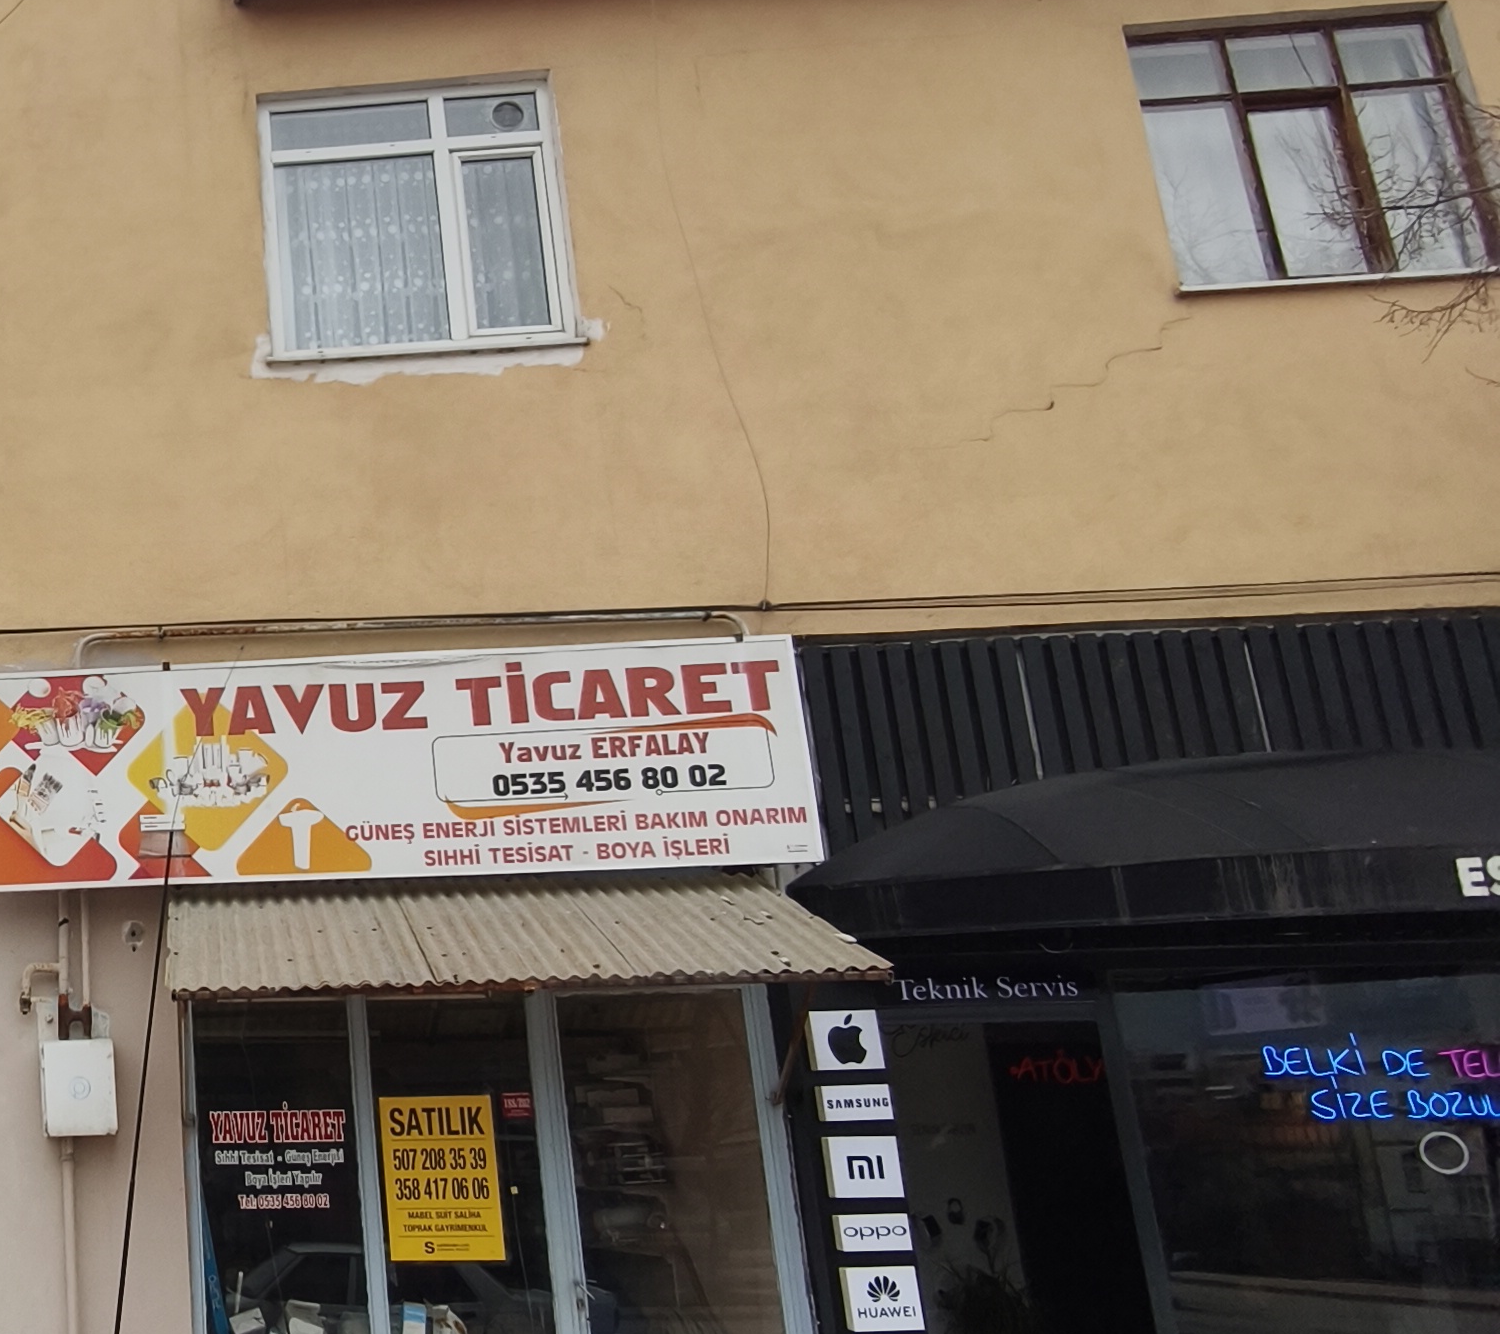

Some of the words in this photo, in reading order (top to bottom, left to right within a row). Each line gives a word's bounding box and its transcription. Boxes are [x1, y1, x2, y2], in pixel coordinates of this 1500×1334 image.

[179, 680, 428, 737] YAVUZ
[455, 660, 780, 727] TİCARET
[498, 742, 581, 763] Yavuz
[591, 732, 709, 759] ERFALAY
[492, 771, 566, 796] 0535
[576, 768, 632, 792] 456
[641, 766, 678, 789] 80
[689, 763, 727, 786] 02
[346, 821, 415, 844] GÜNEŞ
[503, 810, 627, 836] SİSTEMLERİ
[635, 810, 708, 830] BAKIM
[716, 806, 807, 827] ONARIM
[424, 844, 481, 866] SIHHİ
[488, 842, 573, 864] TESİSAT
[596, 842, 656, 860] BOYA
[662, 833, 730, 859] İŞLERİ
[895, 976, 989, 1001] Teknik
[996, 975, 1079, 998] Servis
[1262, 1032, 1366, 1076] BELKİ
[1382, 1049, 1431, 1077] DE
[1437, 1049, 1500, 1078] TEL
[827, 1097, 889, 1110] SAMSUNG
[1311, 1075, 1394, 1120] SİZE
[1407, 1089, 1500, 1118] BOZUL
[209, 1111, 268, 1143] YAVUZ
[270, 1101, 346, 1142] TİCARET
[389, 1106, 485, 1136] SATILIK
[393, 1149, 417, 1171] 507
[420, 1148, 446, 1170] 208
[449, 1148, 467, 1170] 35
[469, 1147, 487, 1169] 39
[245, 1171, 268, 1189] Boya
[395, 1178, 420, 1200] 358
[424, 1178, 448, 1200] 417
[451, 1177, 469, 1200] 06
[472, 1177, 490, 1200] 06
[258, 1194, 281, 1209] 0535
[283, 1194, 301, 1208] 456
[302, 1194, 315, 1208] 80
[316, 1193, 330, 1208] 02
[408, 1211, 433, 1219] MABEL
[454, 1210, 482, 1219] SALİHA
[403, 1224, 433, 1233] TOPRAK
[857, 1306, 917, 1319] HUAWEI
